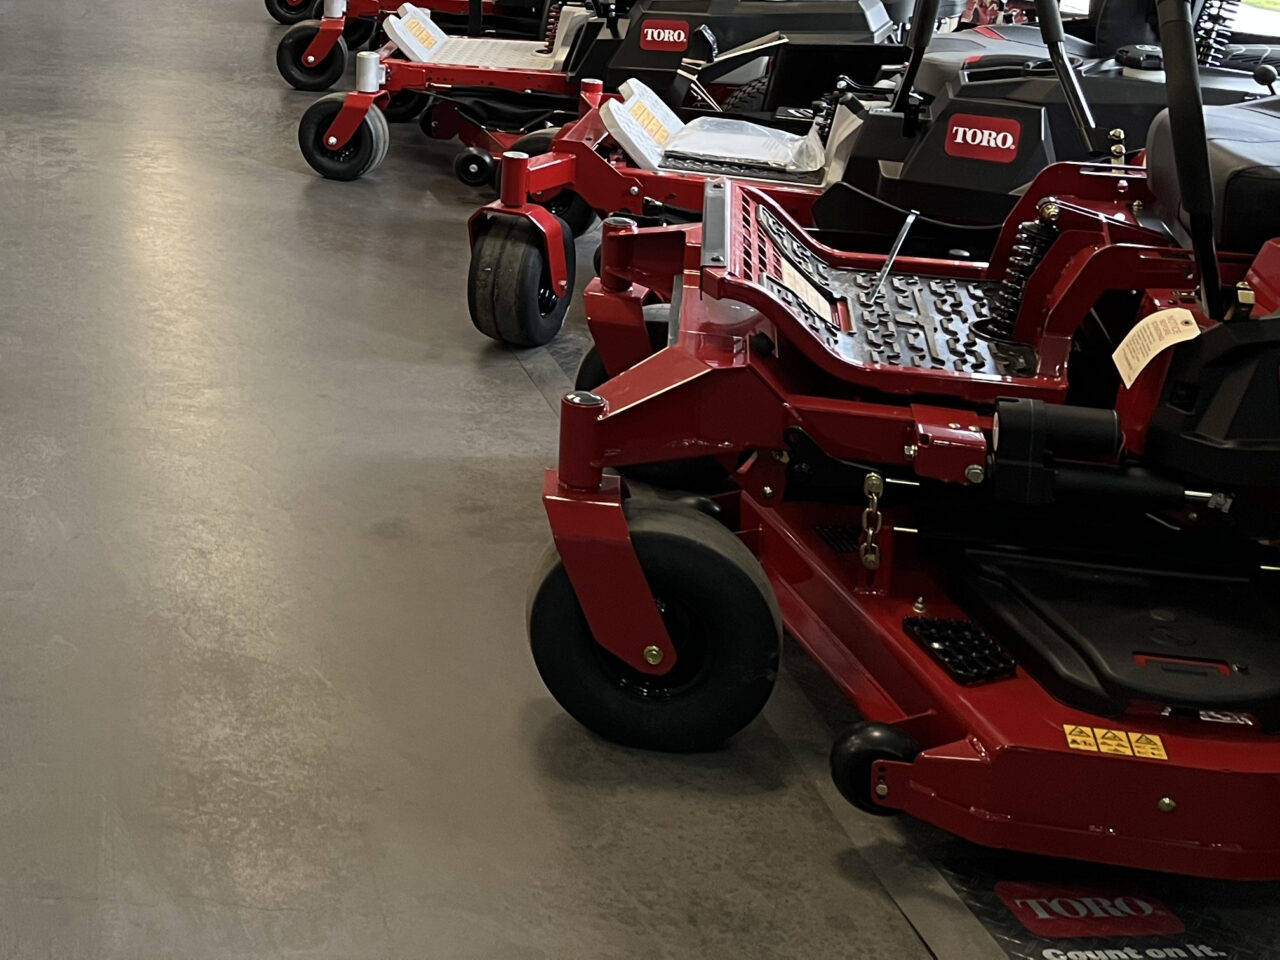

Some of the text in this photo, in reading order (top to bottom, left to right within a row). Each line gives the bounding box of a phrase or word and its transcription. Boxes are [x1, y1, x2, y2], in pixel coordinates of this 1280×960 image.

[644, 28, 687, 42] TORO
[952, 126, 1014, 149] TORO
[1015, 896, 1154, 920] TORO
[1042, 945, 1143, 960] Count
[1145, 946, 1188, 959] on
